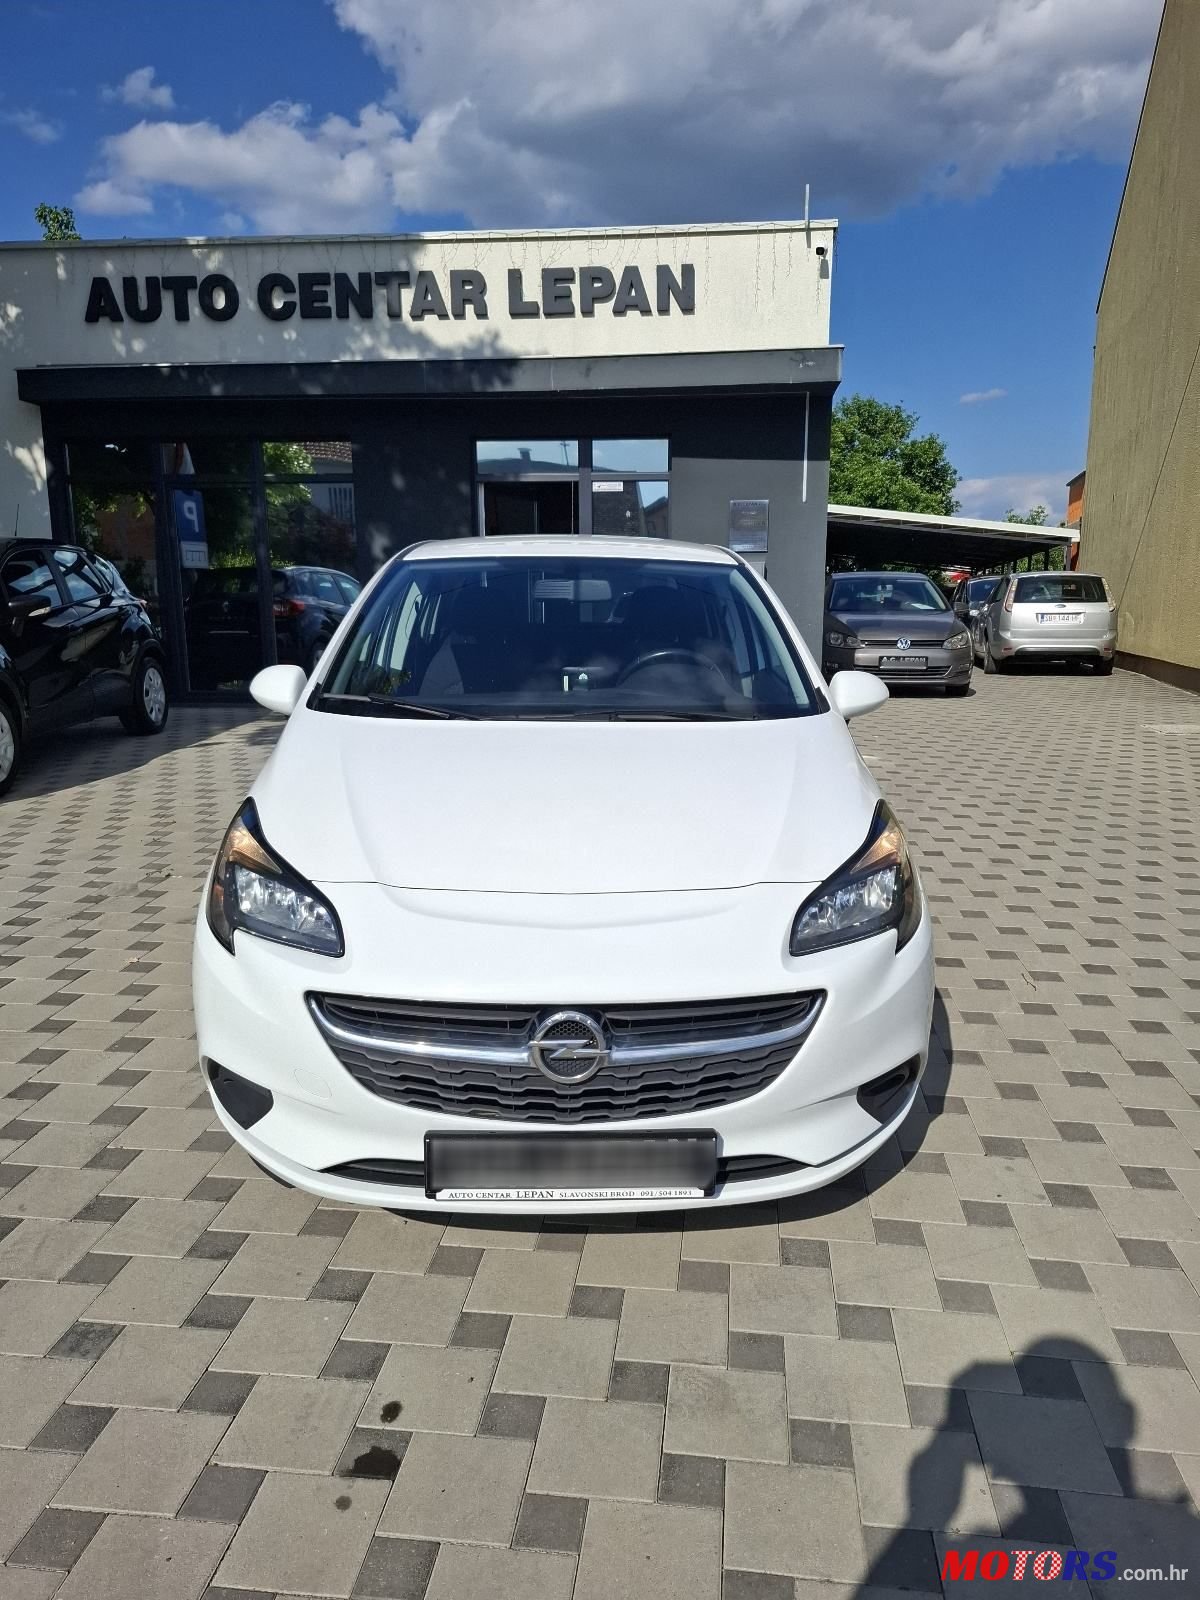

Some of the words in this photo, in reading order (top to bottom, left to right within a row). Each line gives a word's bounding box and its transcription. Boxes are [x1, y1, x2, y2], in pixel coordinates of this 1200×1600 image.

[84, 273, 239, 323] AUTO
[257, 269, 489, 321] CENTAR
[507, 263, 695, 319] LEPAN
[515, 1190, 555, 1199] LEPAN
[610, 1190, 635, 1198] BROD
